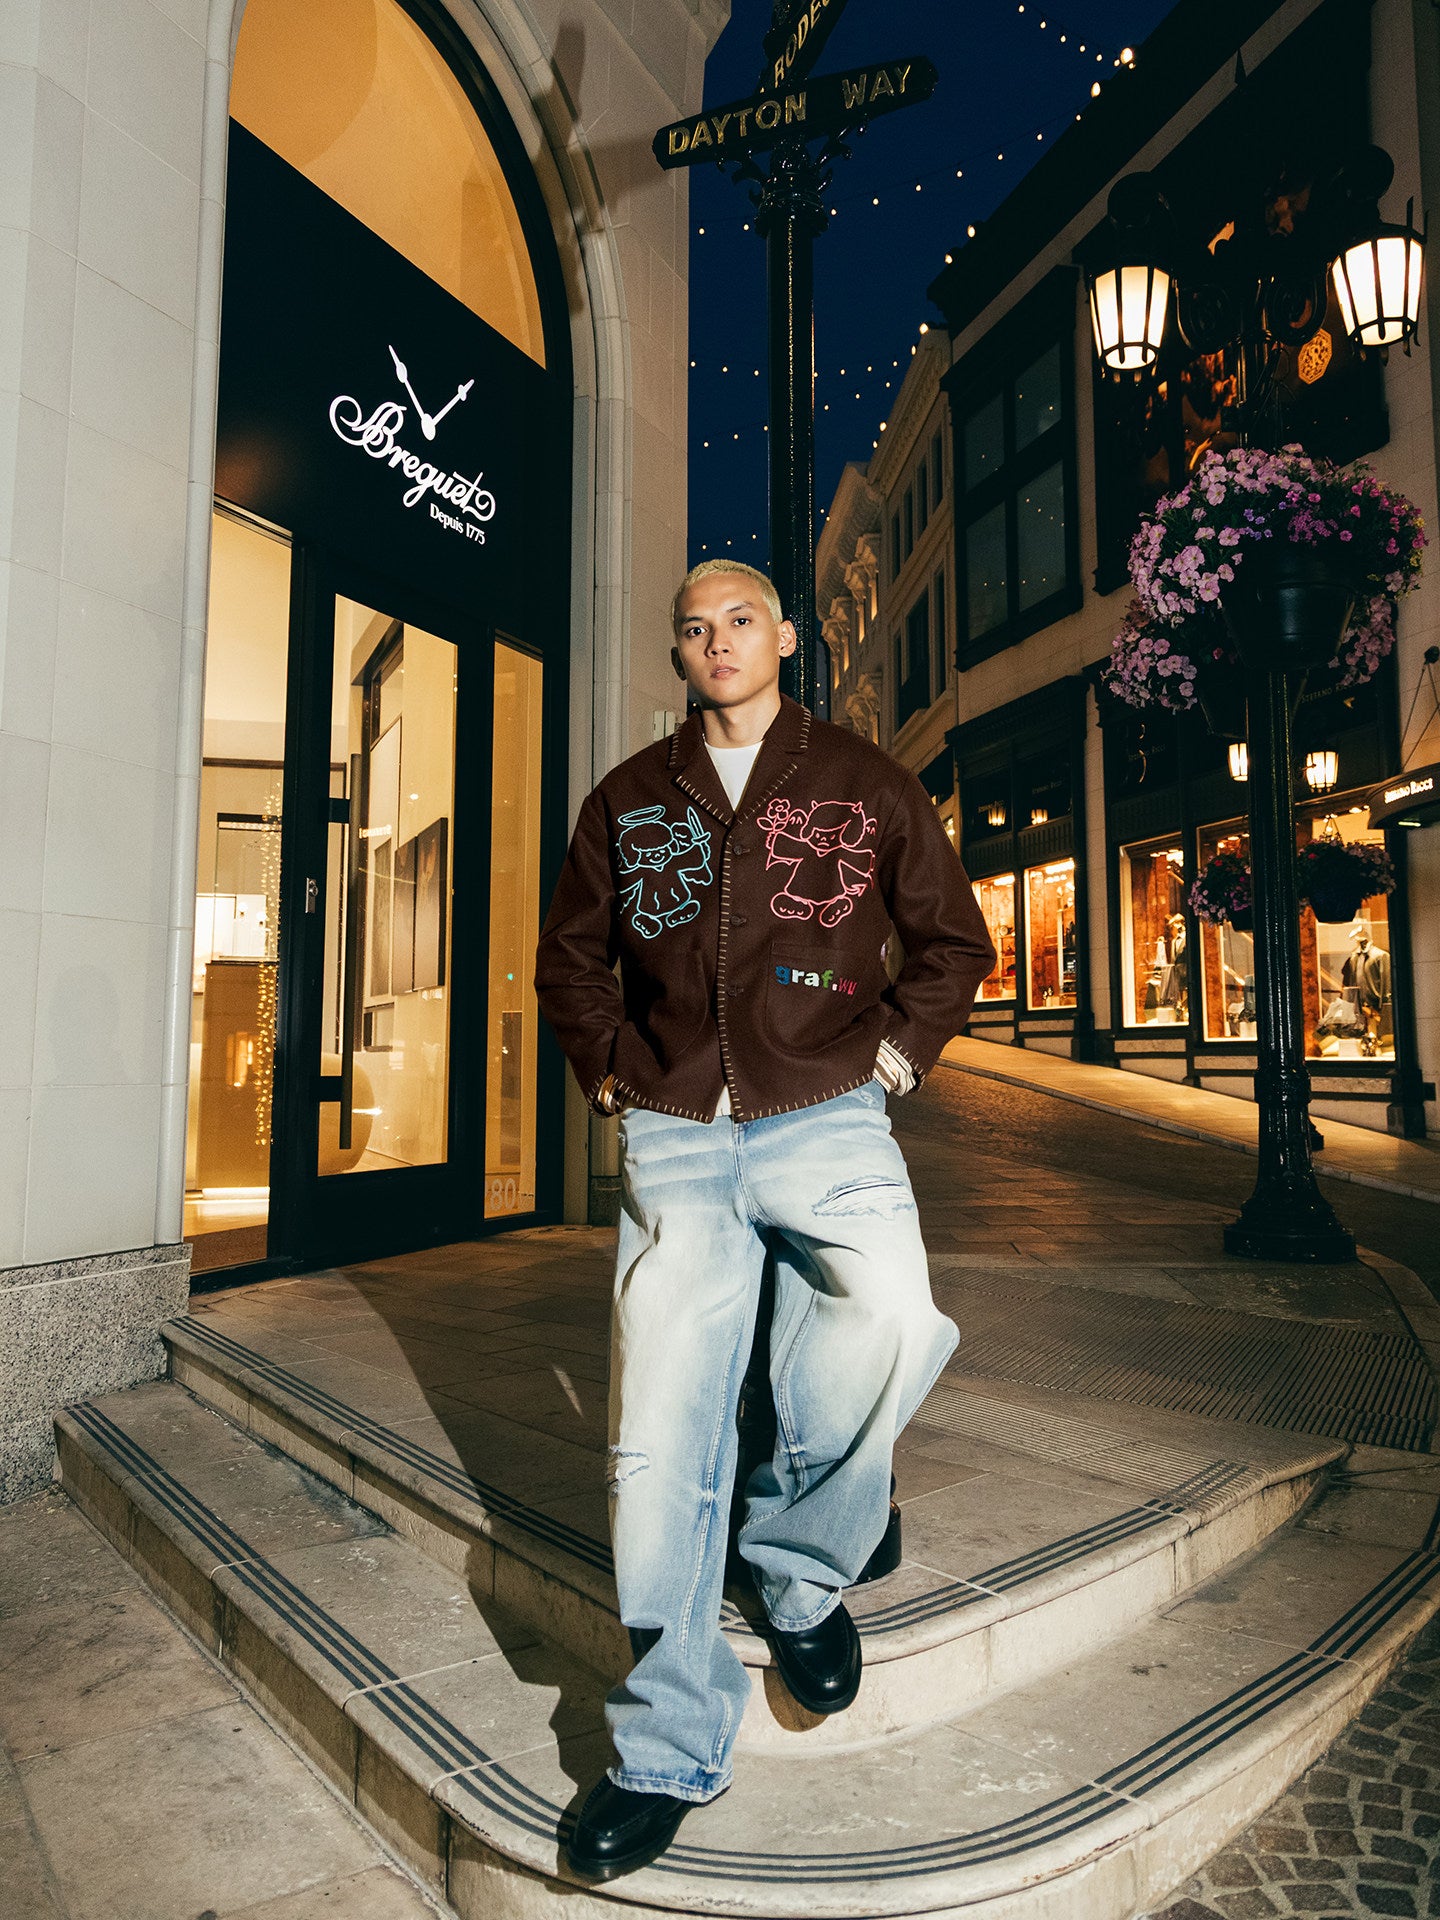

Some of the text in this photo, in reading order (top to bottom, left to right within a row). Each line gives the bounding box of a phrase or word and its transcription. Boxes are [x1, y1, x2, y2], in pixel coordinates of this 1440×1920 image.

[773, 0, 830, 89] RODE
[668, 64, 911, 155] DAYTON WAY
[329, 395, 496, 521] Breguet
[429, 502, 486, 545] Depuis 1775
[490, 1178, 516, 1211] 80
